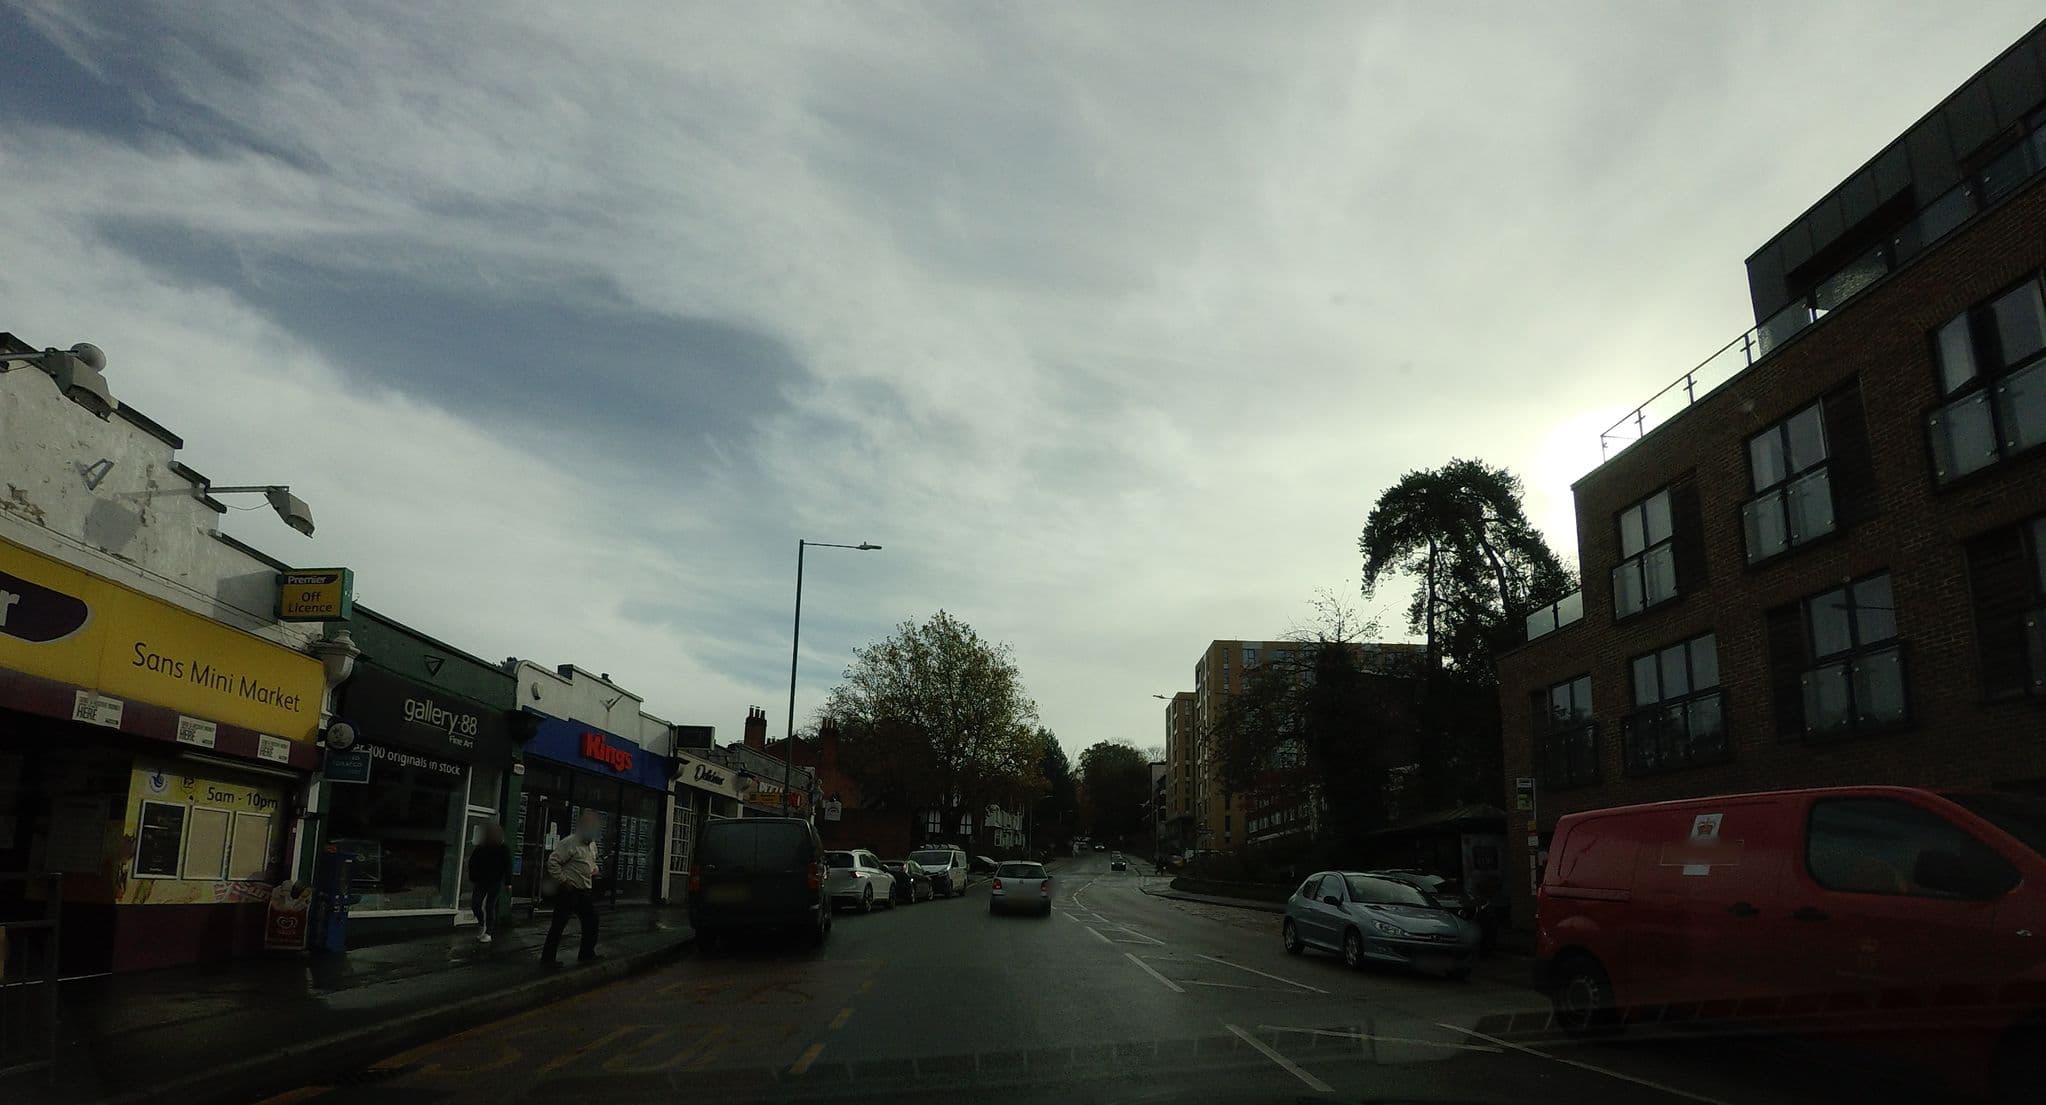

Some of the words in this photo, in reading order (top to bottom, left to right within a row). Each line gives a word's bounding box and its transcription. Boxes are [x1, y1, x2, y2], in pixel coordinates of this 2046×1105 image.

[287, 575, 327, 585] Premier
[288, 603, 333, 613] Licence
[301, 591, 321, 602] Off
[132, 641, 184, 679] Sans
[190, 661, 234, 694] Mini
[239, 675, 301, 713] Market
[387, 750, 428, 768] originals
[428, 761, 438, 770] in
[439, 763, 462, 776] stock
[581, 731, 633, 773] Kings
[207, 786, 235, 803] 5am
[246, 791, 279, 811] 10pm
